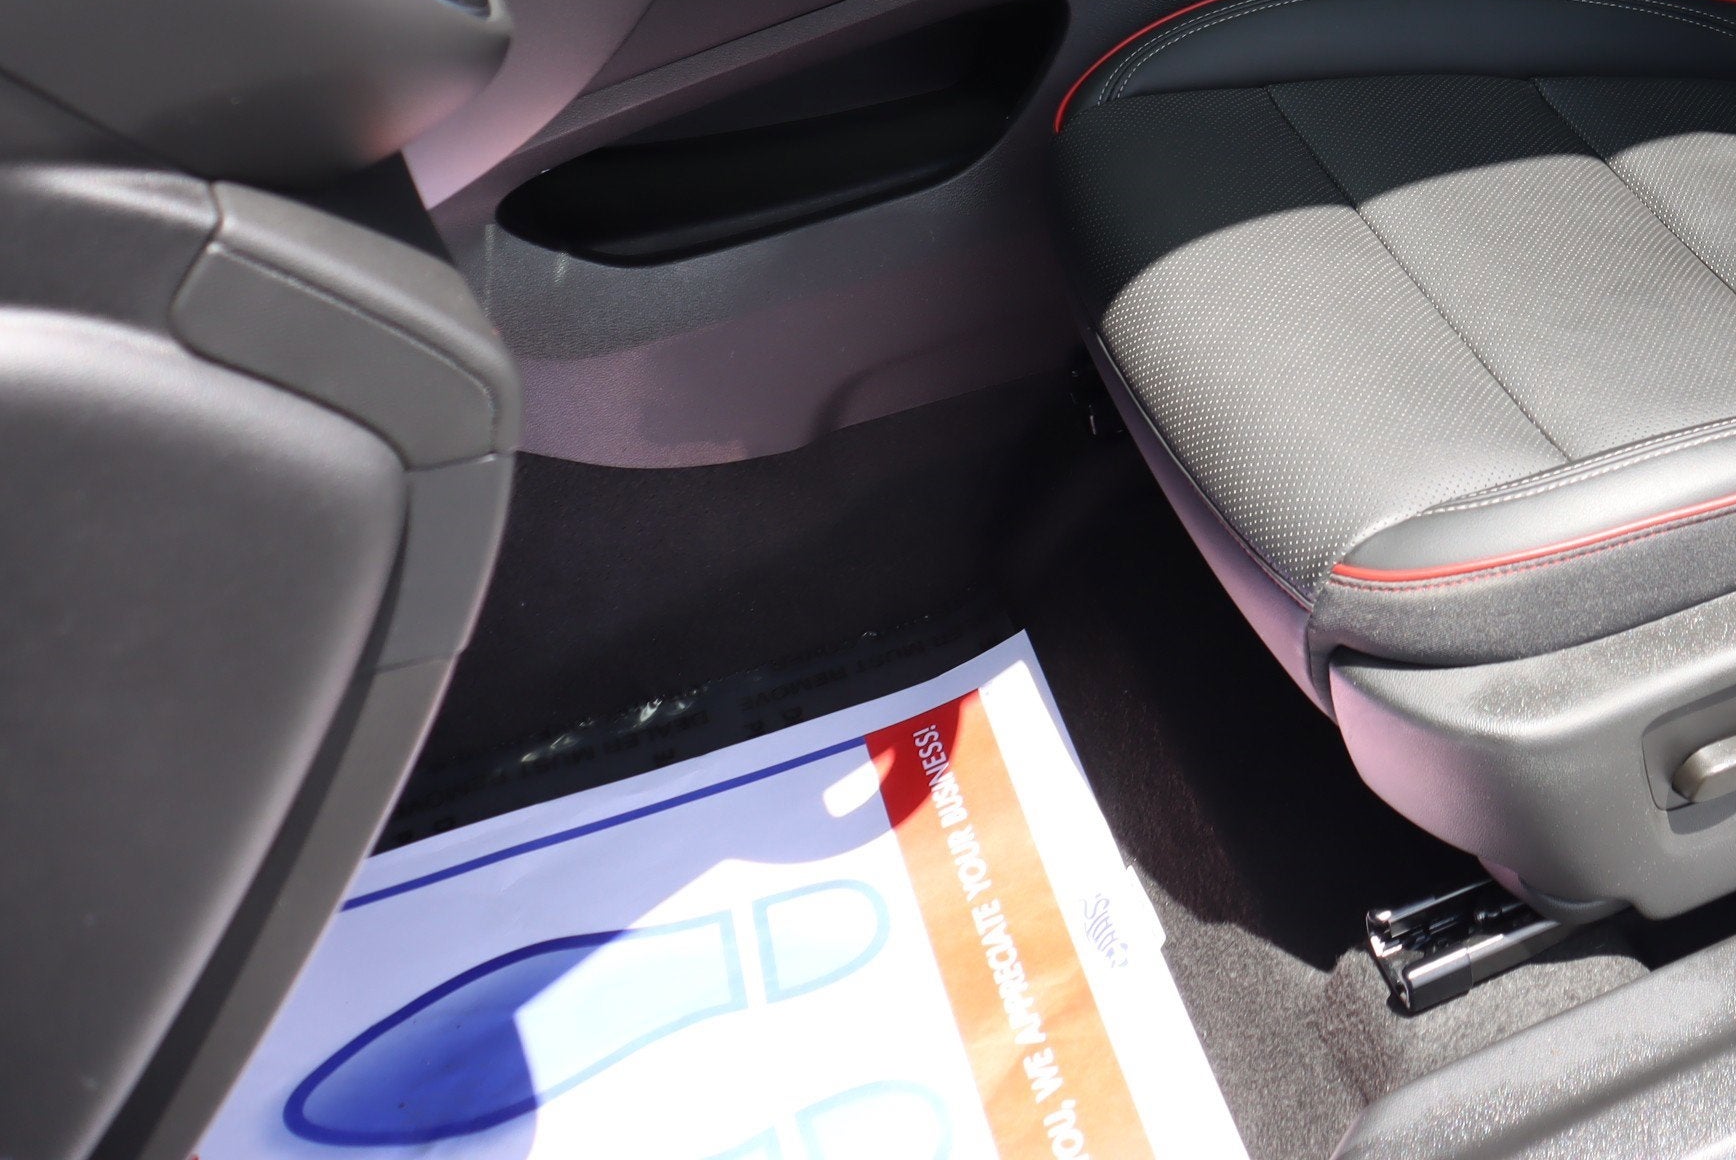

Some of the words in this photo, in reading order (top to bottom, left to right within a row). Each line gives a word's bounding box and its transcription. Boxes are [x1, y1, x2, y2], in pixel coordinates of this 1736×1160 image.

[912, 724, 968, 829] BUSINESS!
[947, 824, 993, 903] YOUR
[971, 898, 1047, 1045] APPRECIATE
[1022, 1046, 1065, 1104] WE
